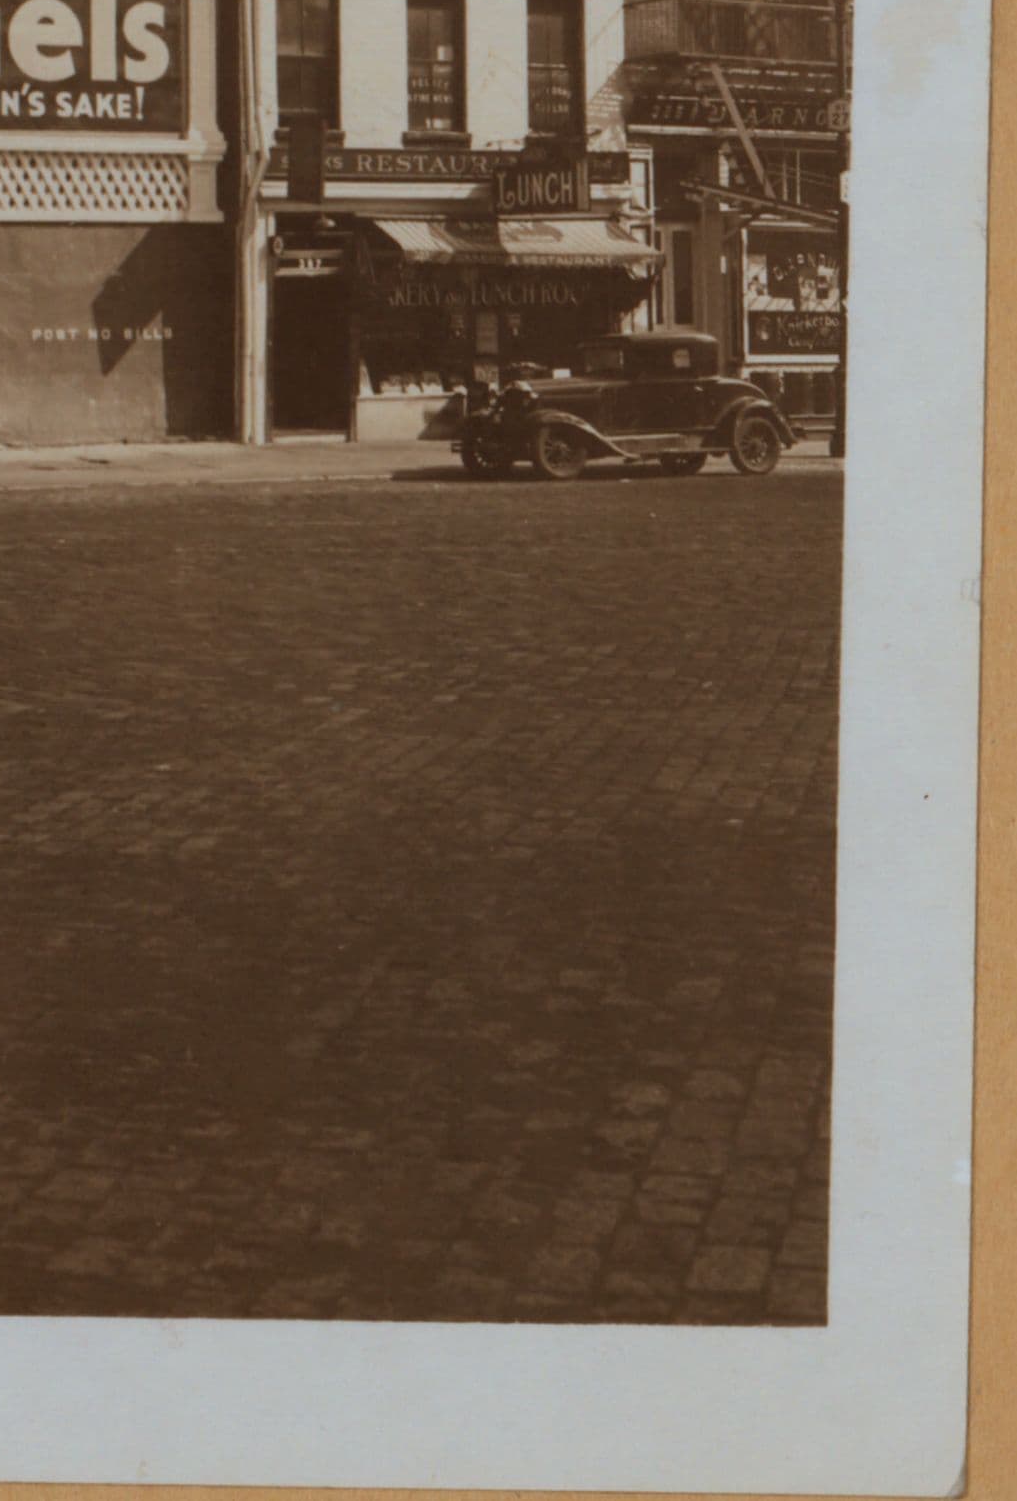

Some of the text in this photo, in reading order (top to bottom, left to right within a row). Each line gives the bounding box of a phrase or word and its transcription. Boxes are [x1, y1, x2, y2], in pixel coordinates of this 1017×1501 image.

[55, 86, 145, 121] SAKE!
[496, 169, 574, 209] LUNCH
[522, 255, 613, 267] RESTAURANT
[32, 327, 173, 341] POST NO BILLS
